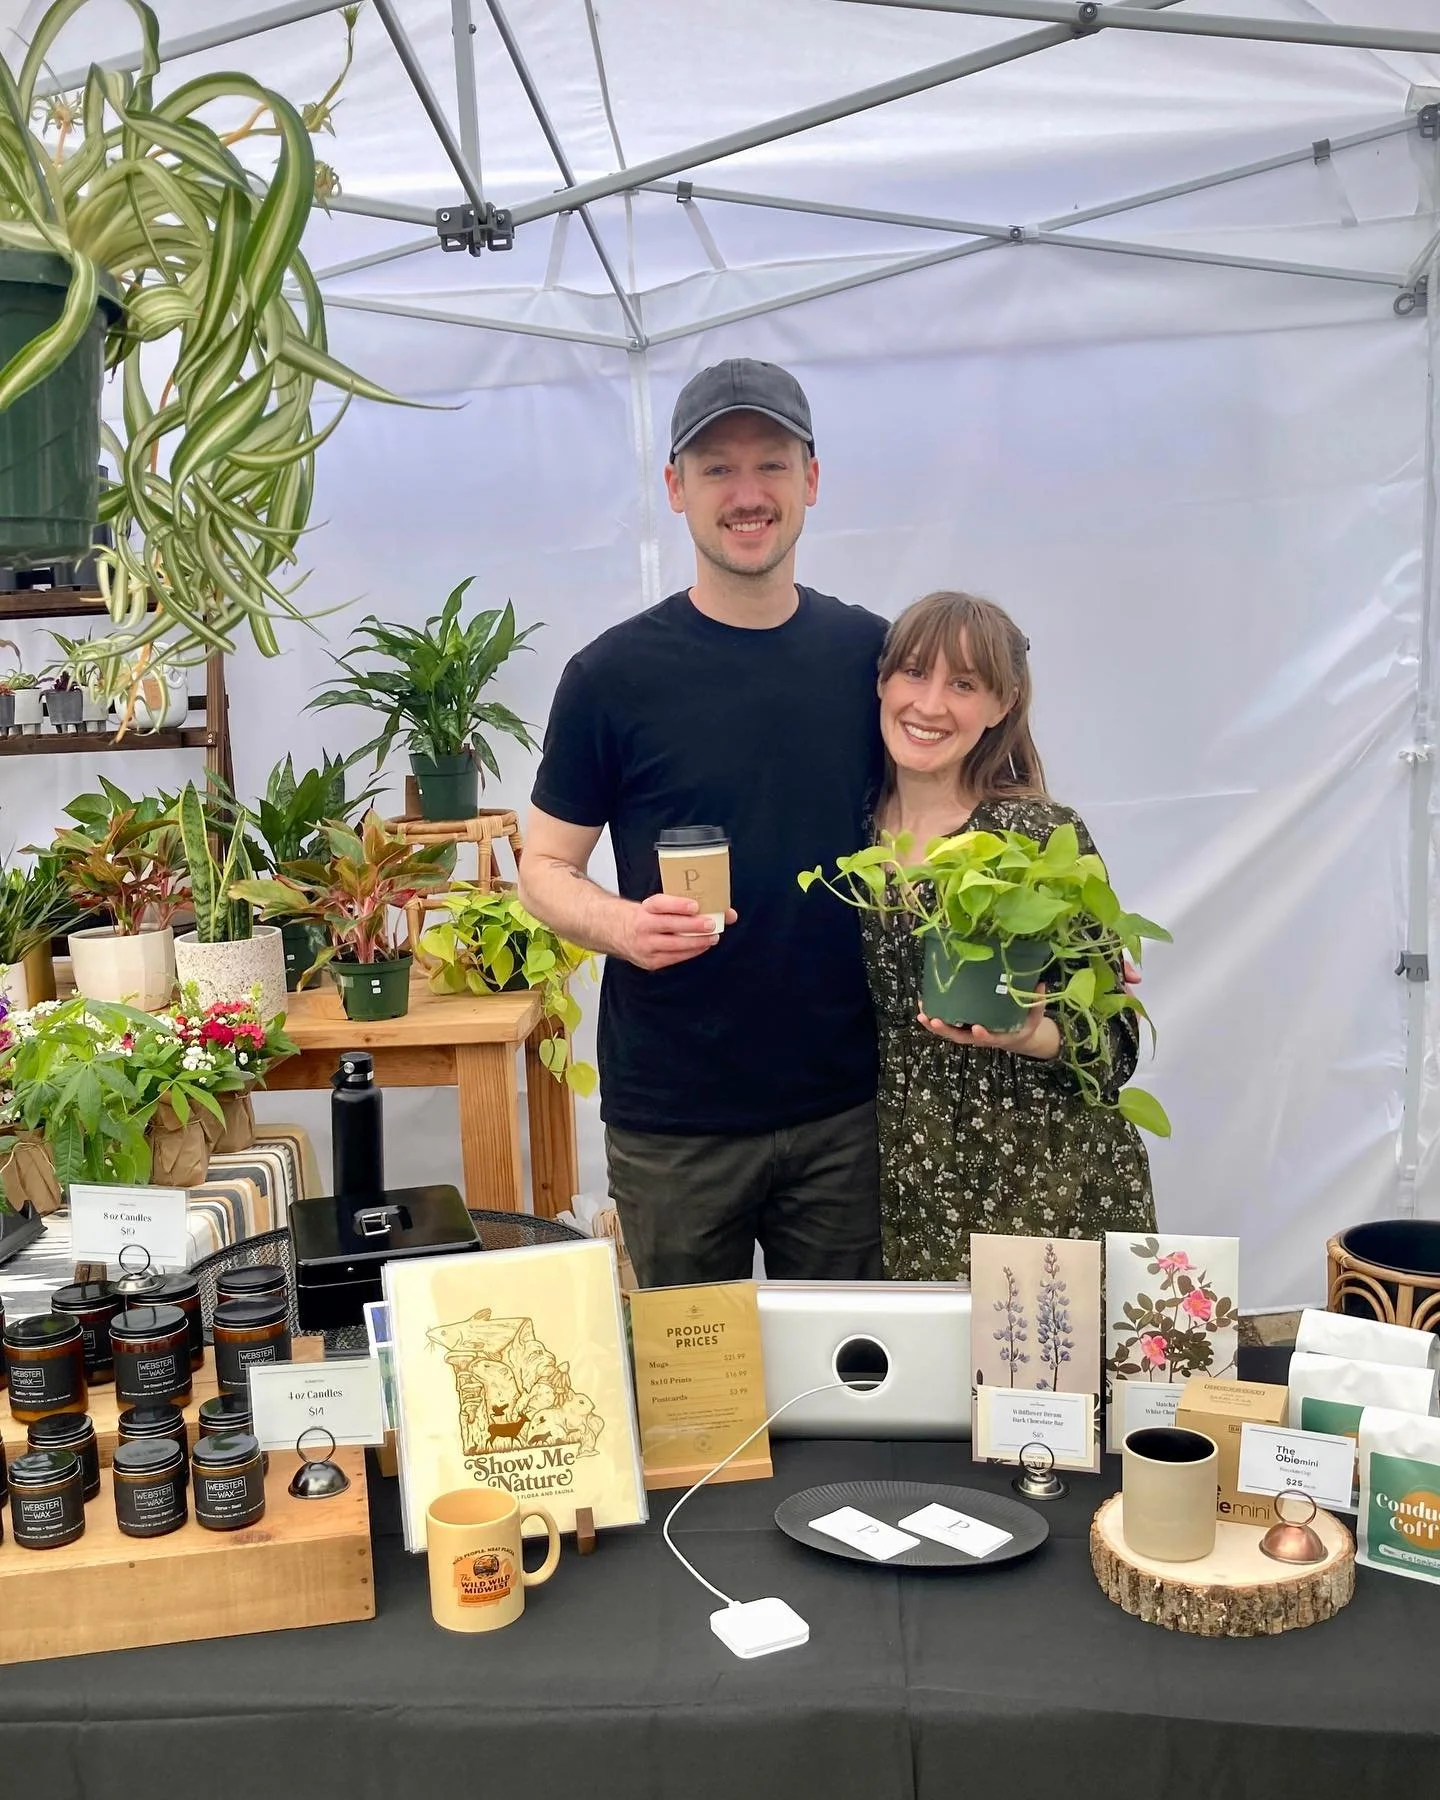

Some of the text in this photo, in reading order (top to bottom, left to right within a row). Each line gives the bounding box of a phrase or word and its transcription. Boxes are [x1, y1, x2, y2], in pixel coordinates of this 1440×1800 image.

[684, 868, 700, 890] P
[104, 1212, 109, 1220] 8
[120, 1212, 152, 1222] Candles
[666, 1323, 726, 1338] PRODUCT
[676, 1336, 718, 1348] PRICES
[240, 1349, 273, 1360] WEBSTER
[140, 1358, 172, 1370] WEBSTER
[13, 1370, 41, 1378] WEBSTER
[148, 1369, 166, 1377] WAX
[650, 1377, 668, 1386] 8x10
[670, 1376, 692, 1384] Prints
[288, 1391, 294, 1400] 4
[307, 1388, 343, 1400] Candles
[652, 1394, 688, 1404] Postcards
[308, 1406, 324, 1416] $14
[1026, 1418, 1054, 1426] Chocolate
[1276, 1445, 1296, 1456] The
[464, 1448, 575, 1482] Show Me
[1275, 1454, 1319, 1468] Obiemini
[208, 1480, 244, 1490] WEBSTER
[488, 1468, 573, 1492] Nature
[1286, 1478, 1303, 1486] $25
[136, 1486, 172, 1500] WEBSTER
[217, 1490, 235, 1498] WAX
[520, 1492, 539, 1500] FLORA
[554, 1488, 574, 1496] FAUNA
[24, 1500, 60, 1512] WEBSTER
[146, 1498, 164, 1507] WAX
[1217, 1497, 1270, 1520] iemini
[1376, 1492, 1440, 1522] Condu
[33, 1512, 50, 1520] WAX
[1390, 1516, 1440, 1540] Coff
[488, 1574, 510, 1586] WILD
[464, 1582, 508, 1594] MIDWEST
